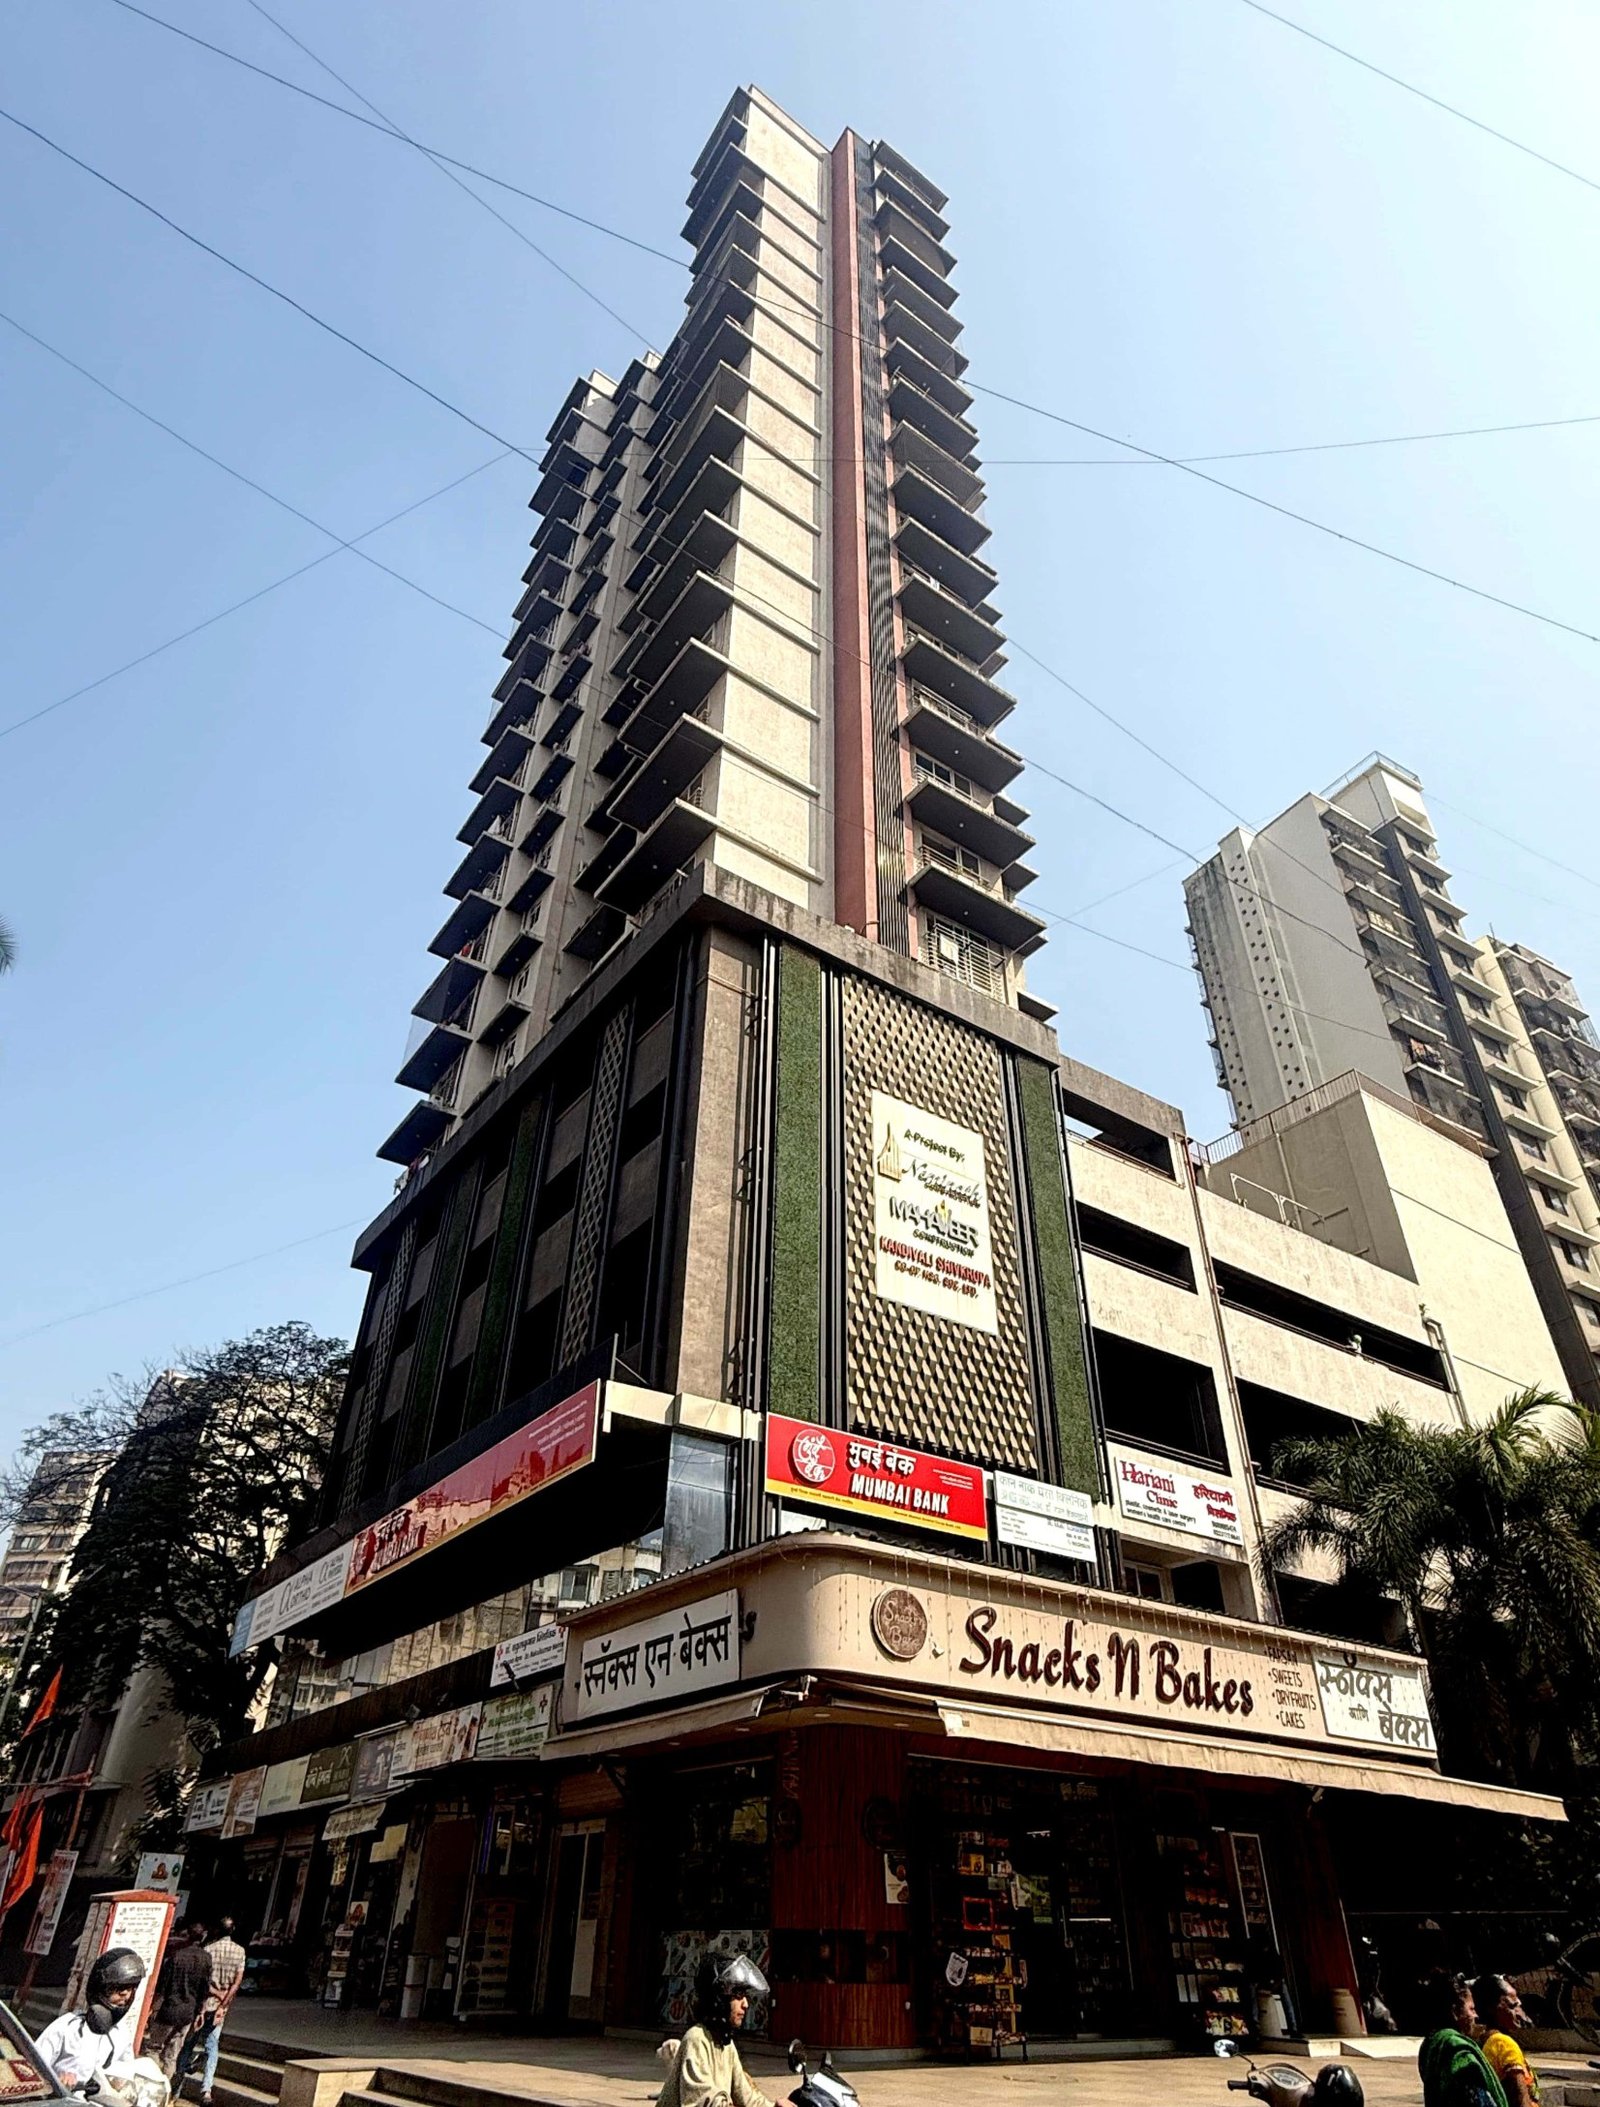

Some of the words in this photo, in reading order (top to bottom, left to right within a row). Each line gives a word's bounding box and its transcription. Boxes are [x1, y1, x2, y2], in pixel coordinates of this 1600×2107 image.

[889, 1196, 979, 1248] MAHAVEER
[879, 1236, 933, 1268] KANDIVALI
[936, 1257, 991, 1290] SHIVKRUPA
[848, 1439, 883, 1469] मुंबई
[851, 1473, 910, 1507] MUMBAI
[913, 1488, 950, 1515] BANK
[1119, 1460, 1176, 1494] Hariani
[1146, 1490, 1178, 1509] Clinic
[645, 1634, 674, 1689] एन
[679, 1611, 733, 1671] बेक्स
[959, 1606, 1101, 1693] Snacks
[1150, 1640, 1255, 1717] Bakes
[1272, 1668, 1303, 1688] SWEETS
[1275, 1689, 1317, 1711] DRYFRUITS
[1279, 1710, 1306, 1730] CAKES
